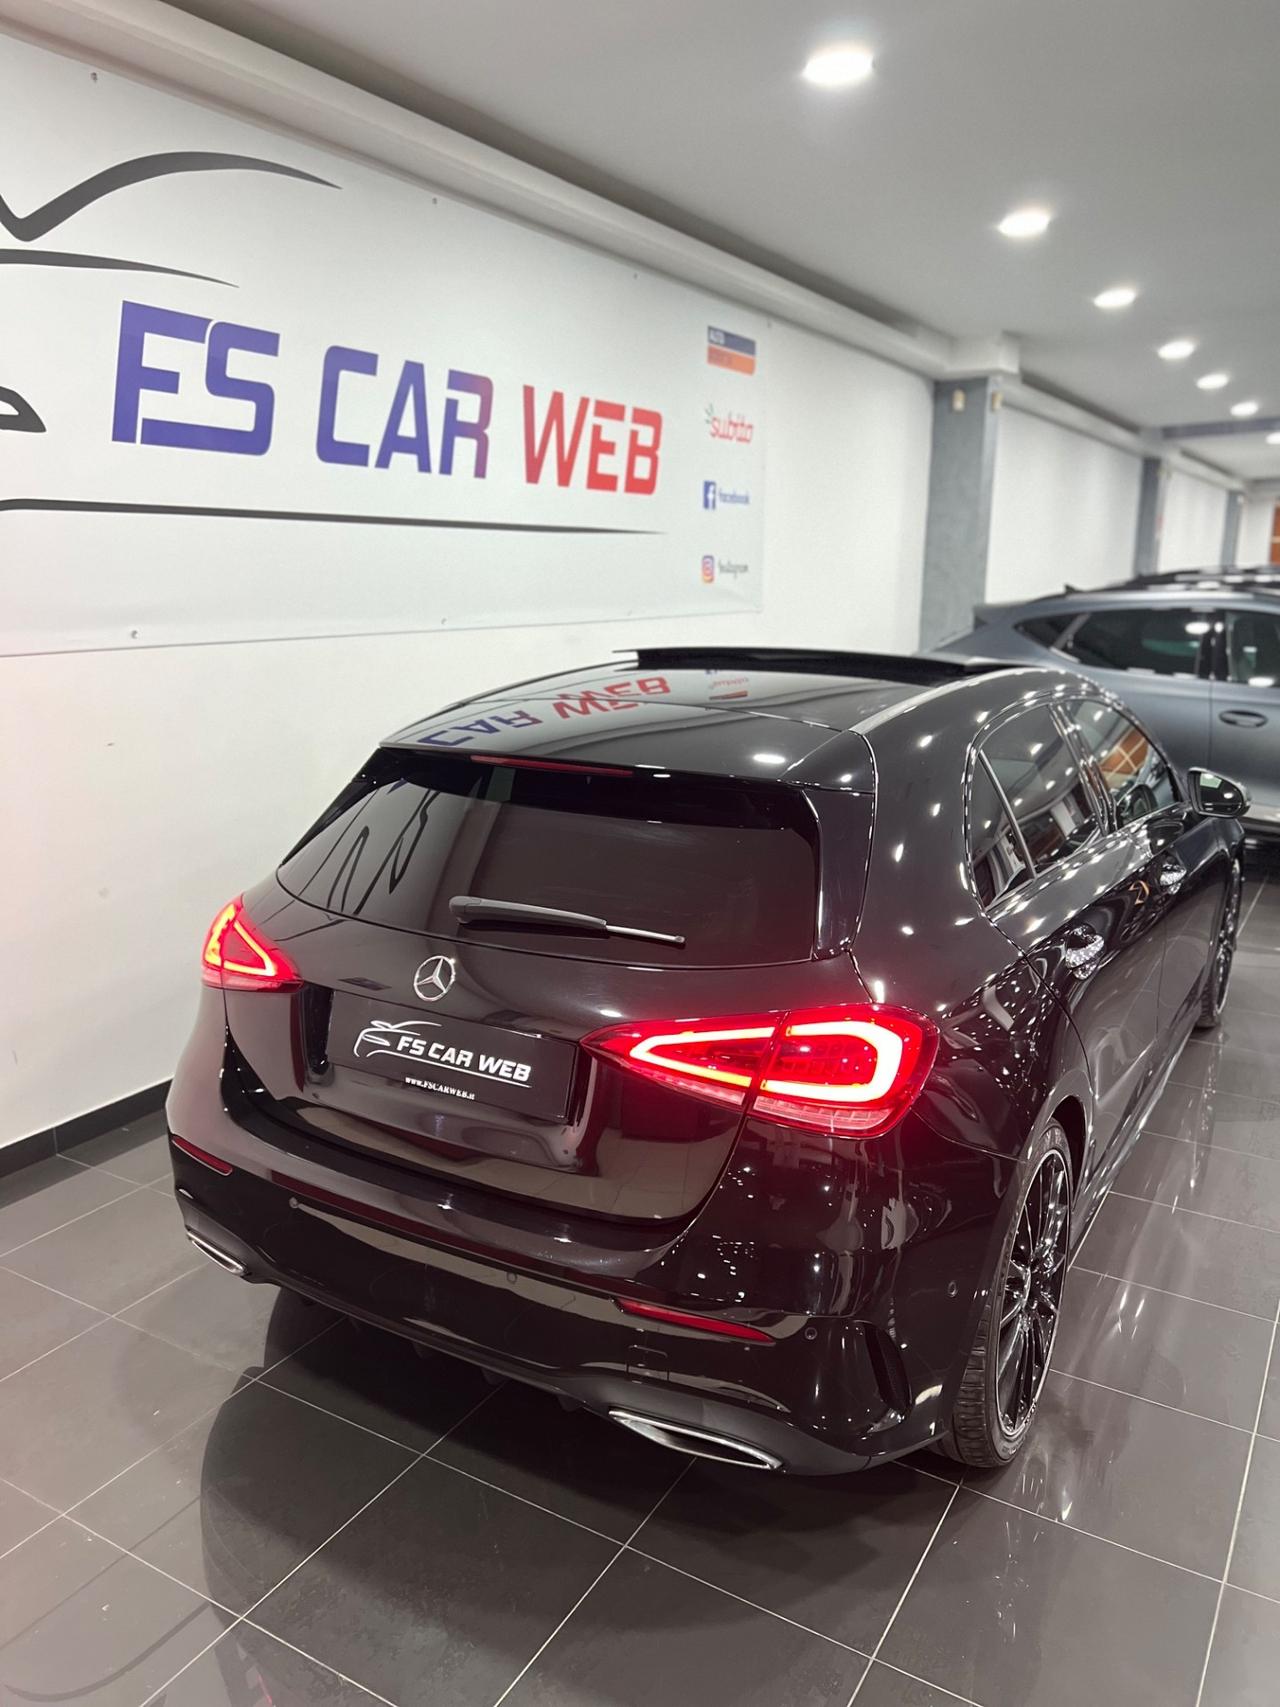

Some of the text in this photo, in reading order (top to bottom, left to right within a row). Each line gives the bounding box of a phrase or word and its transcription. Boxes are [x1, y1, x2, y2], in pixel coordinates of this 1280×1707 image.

[316, 345, 494, 479] CAR
[522, 384, 663, 495] WEB
[397, 1035, 532, 1082] FS CAR WEB
